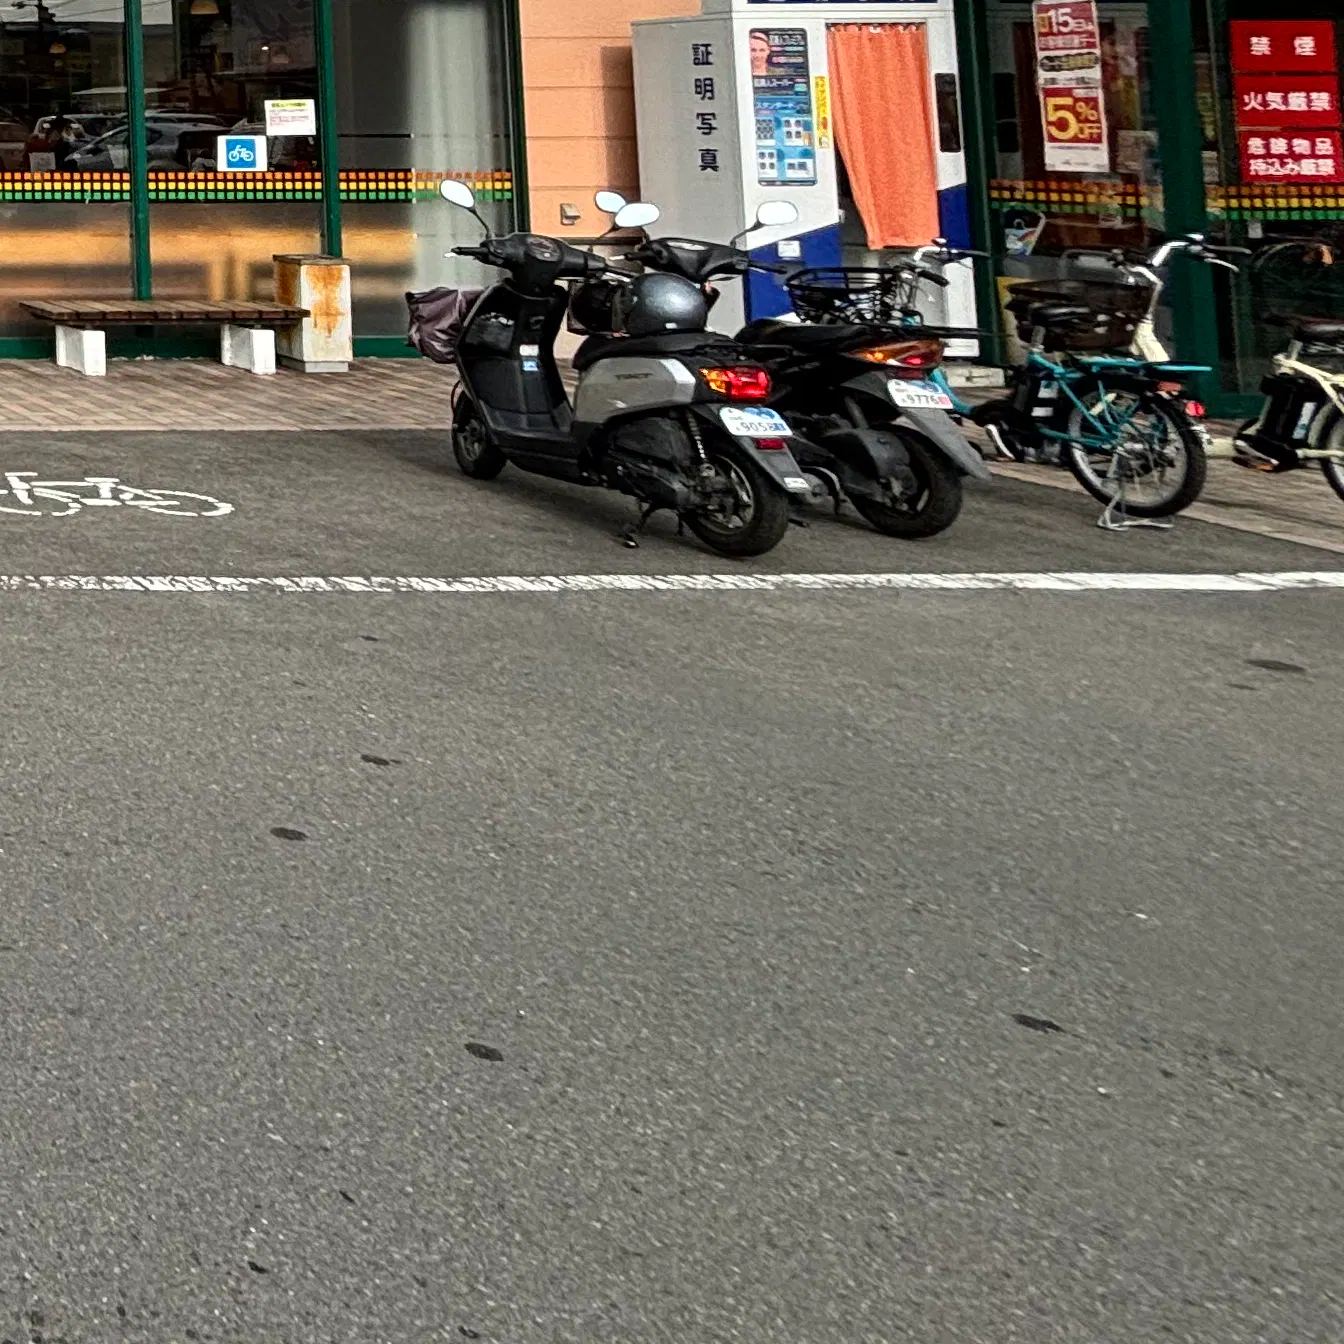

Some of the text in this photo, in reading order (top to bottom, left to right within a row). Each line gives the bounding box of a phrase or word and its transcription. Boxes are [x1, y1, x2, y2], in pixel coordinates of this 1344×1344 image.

[1249, 36, 1317, 56] 禁煙
[692, 43, 719, 172] 証明写真
[1243, 91, 1332, 111] 火気厳禁
[1247, 137, 1334, 155] 危険物品
[1249, 158, 1335, 176] 持込み厳禁
